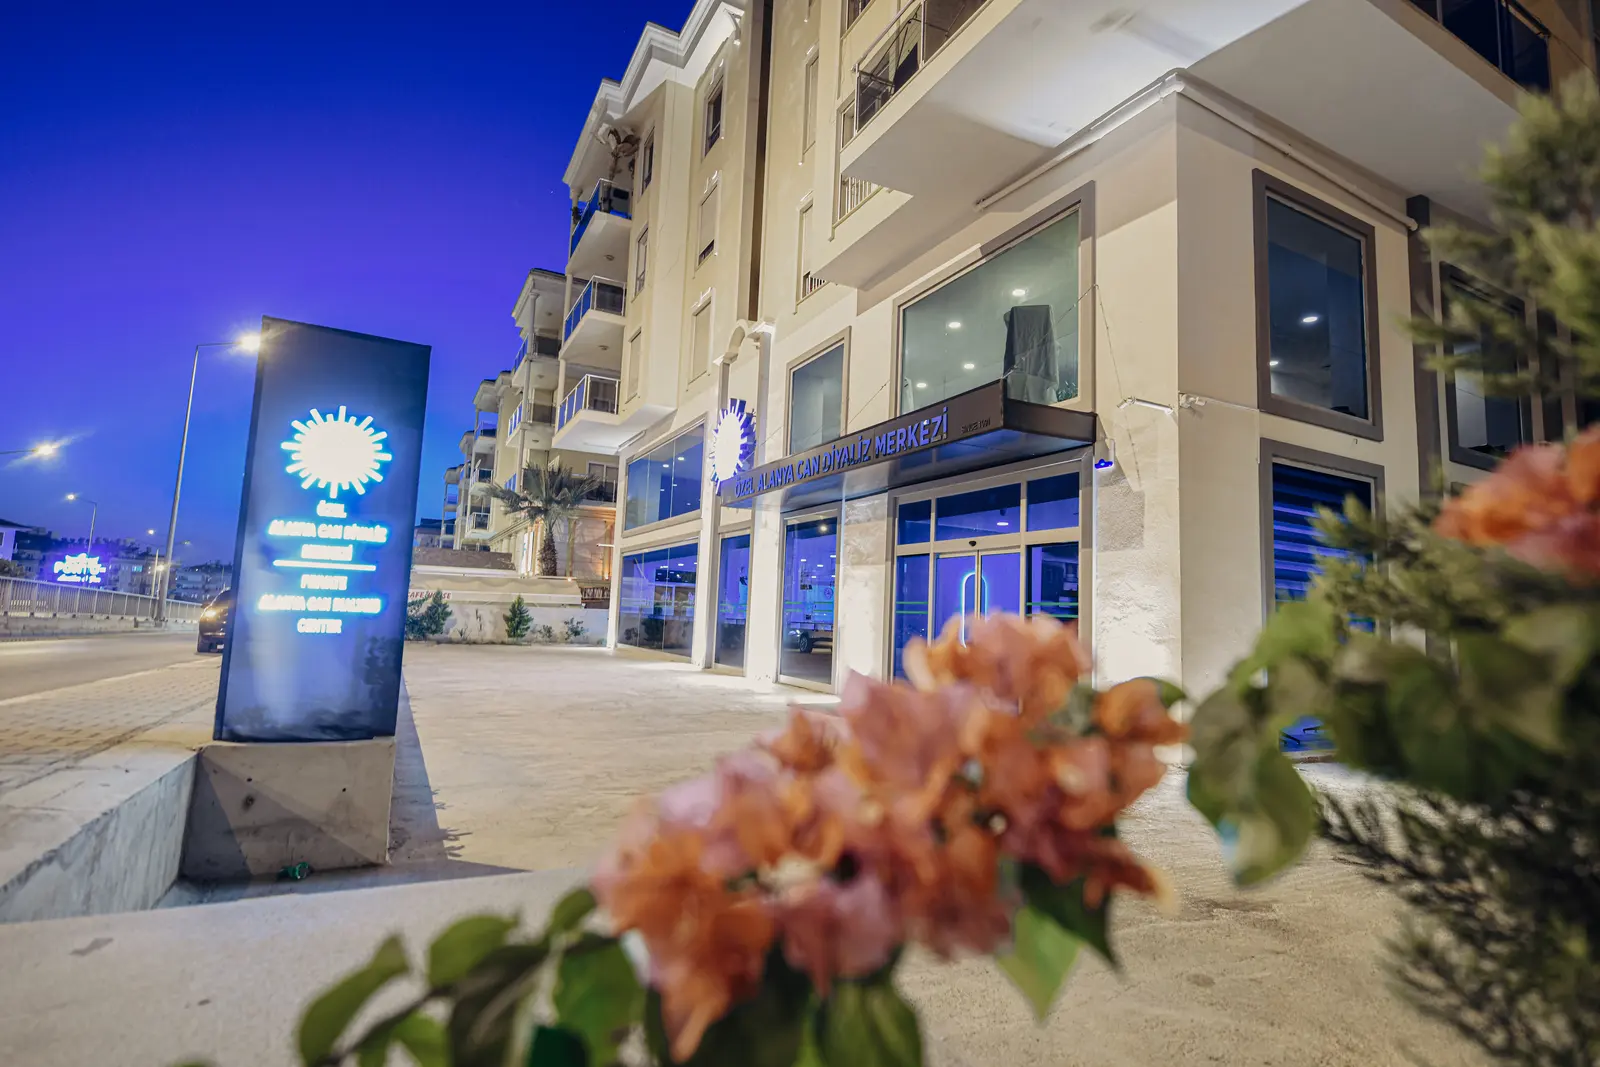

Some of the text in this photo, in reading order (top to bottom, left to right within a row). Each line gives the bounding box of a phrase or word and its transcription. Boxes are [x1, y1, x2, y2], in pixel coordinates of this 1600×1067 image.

[735, 406, 948, 498] ÖZEL ALANYA CAN DİYALİZ MERKEZİ
